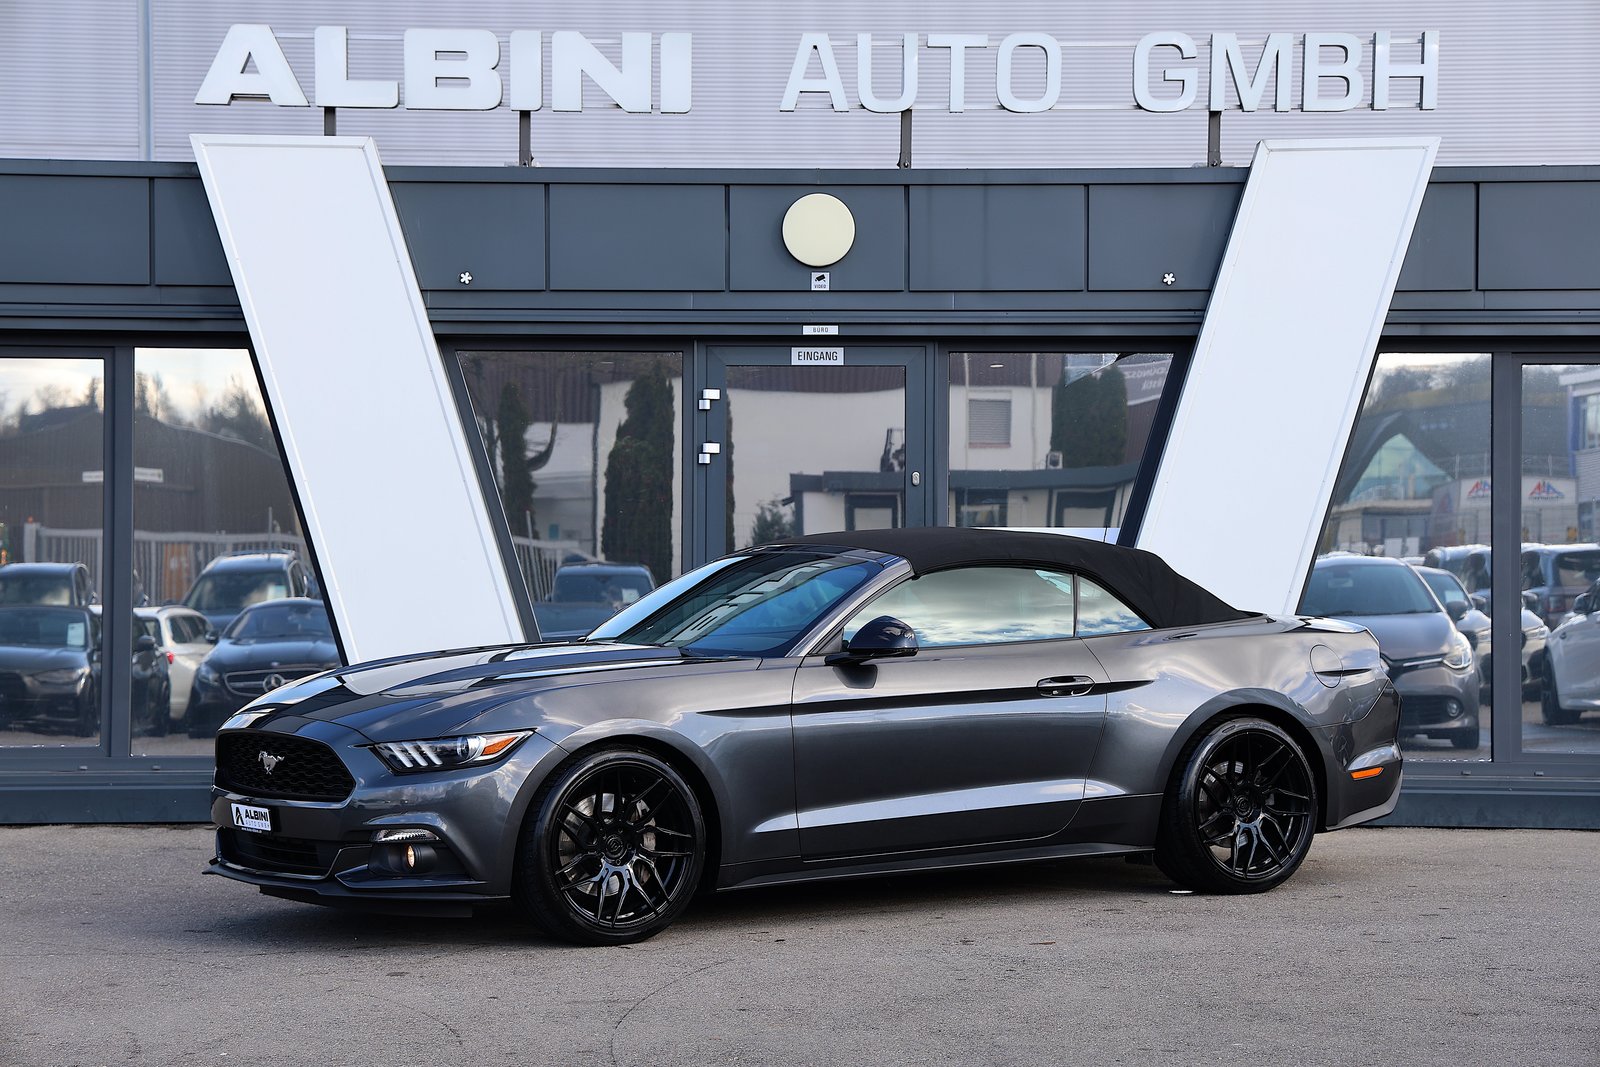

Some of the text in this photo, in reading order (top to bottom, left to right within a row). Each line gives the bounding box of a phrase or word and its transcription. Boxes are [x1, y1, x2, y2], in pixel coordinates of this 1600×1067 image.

[194, 23, 1440, 114] ALBINI AUTO GMBH
[797, 351, 838, 361] EINGANG
[244, 809, 268, 822] ALBINI
